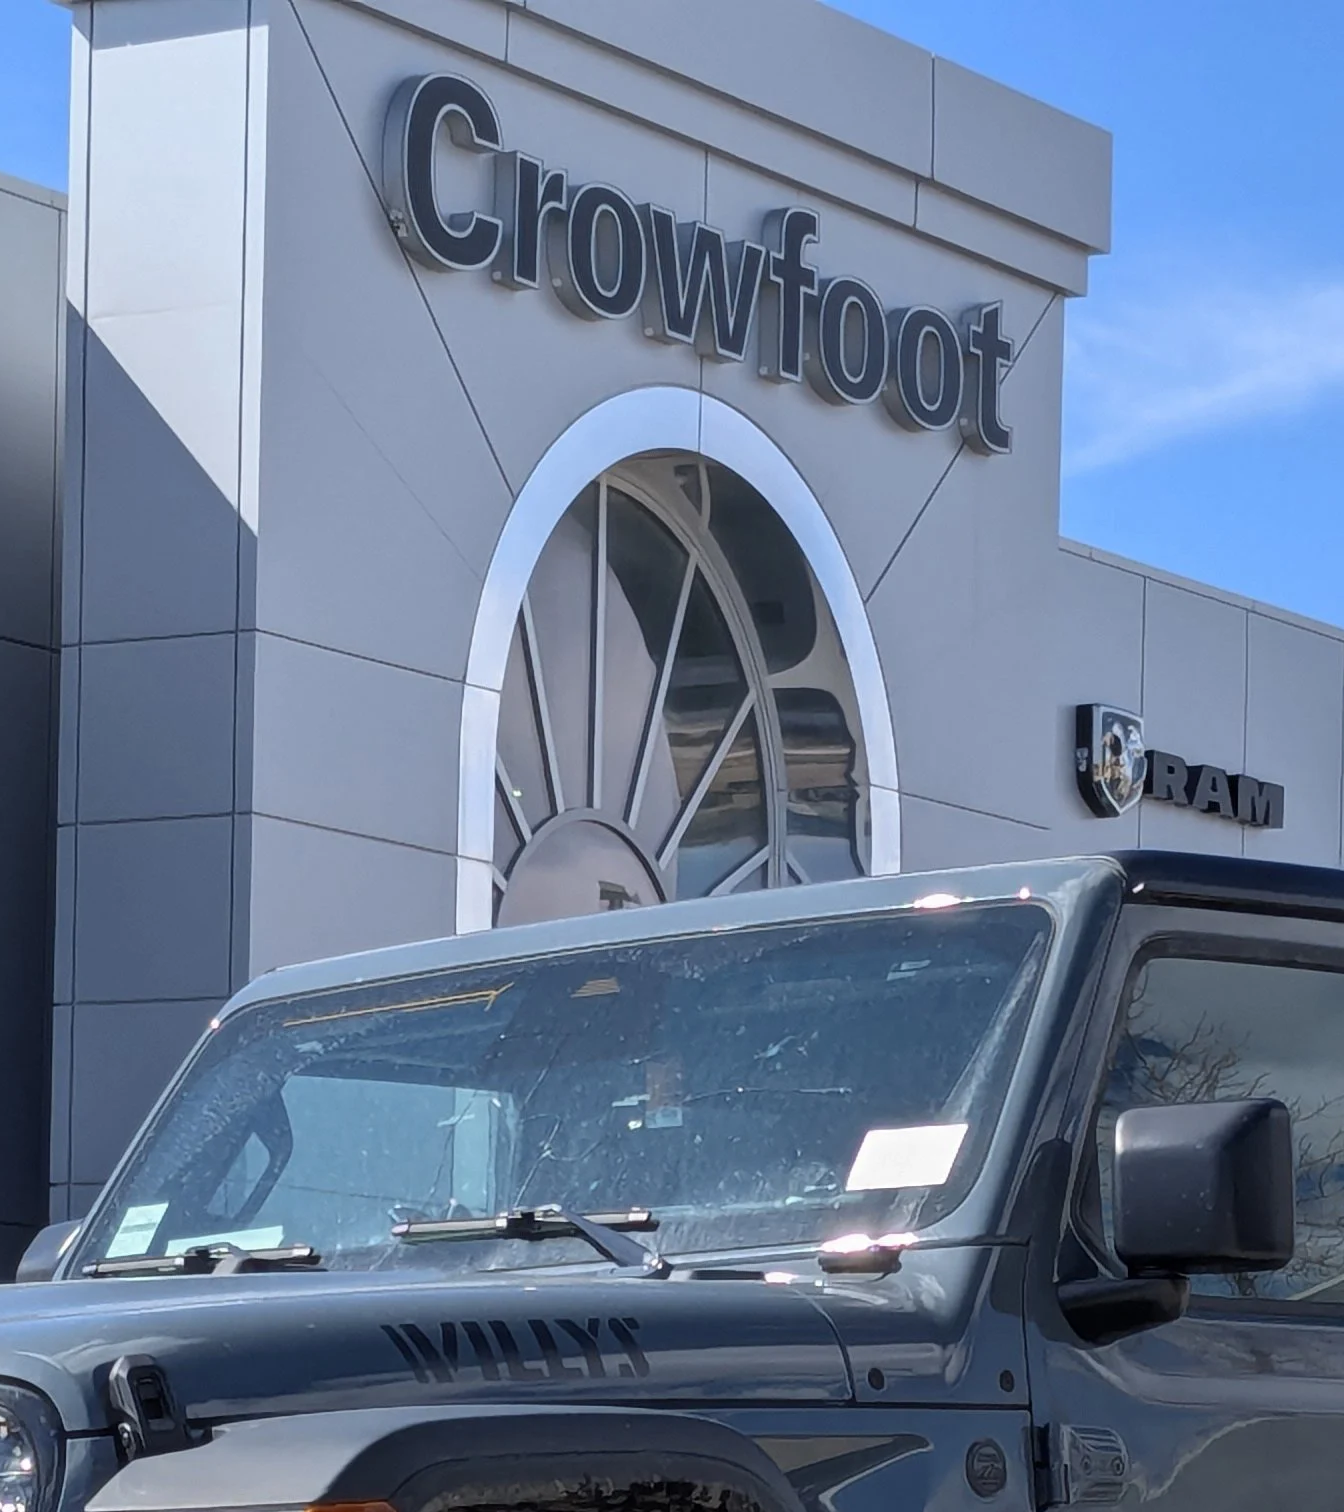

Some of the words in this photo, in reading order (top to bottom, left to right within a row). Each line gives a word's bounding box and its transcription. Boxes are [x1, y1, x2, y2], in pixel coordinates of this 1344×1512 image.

[388, 71, 1015, 455] Crowfoot
[1147, 749, 1285, 830] RAM
[380, 1316, 651, 1385] WILLYS
